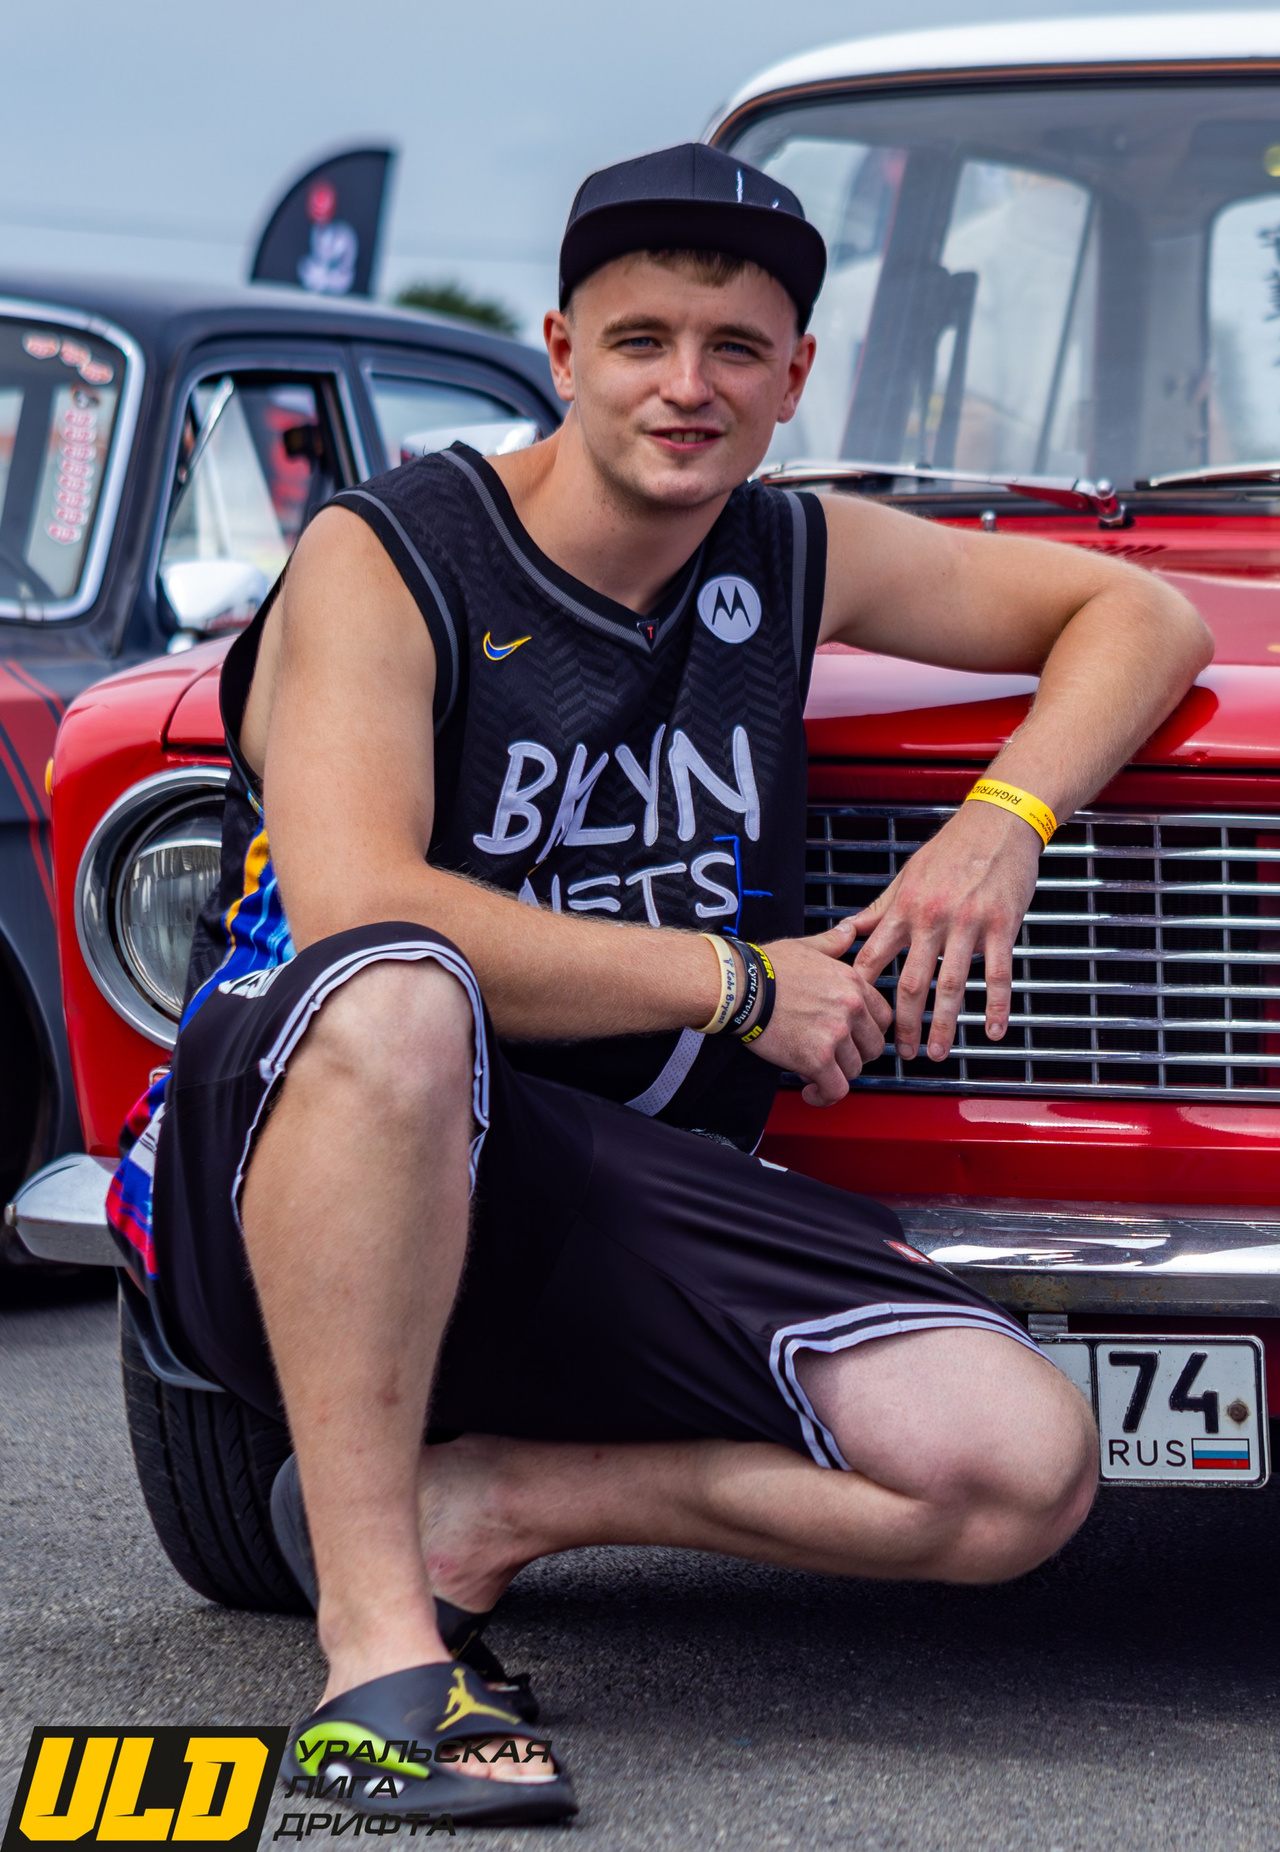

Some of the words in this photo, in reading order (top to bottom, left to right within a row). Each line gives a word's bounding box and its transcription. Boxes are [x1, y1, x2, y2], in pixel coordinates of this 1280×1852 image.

[473, 723, 761, 864] BKLYN
[726, 969, 736, 991] Kobe
[747, 962, 759, 992] Kyrie
[717, 993, 735, 1024] Bryant
[734, 993, 757, 1025] Irving
[1108, 1351, 1219, 1434] 74
[1108, 1439, 1187, 1467] RUS
